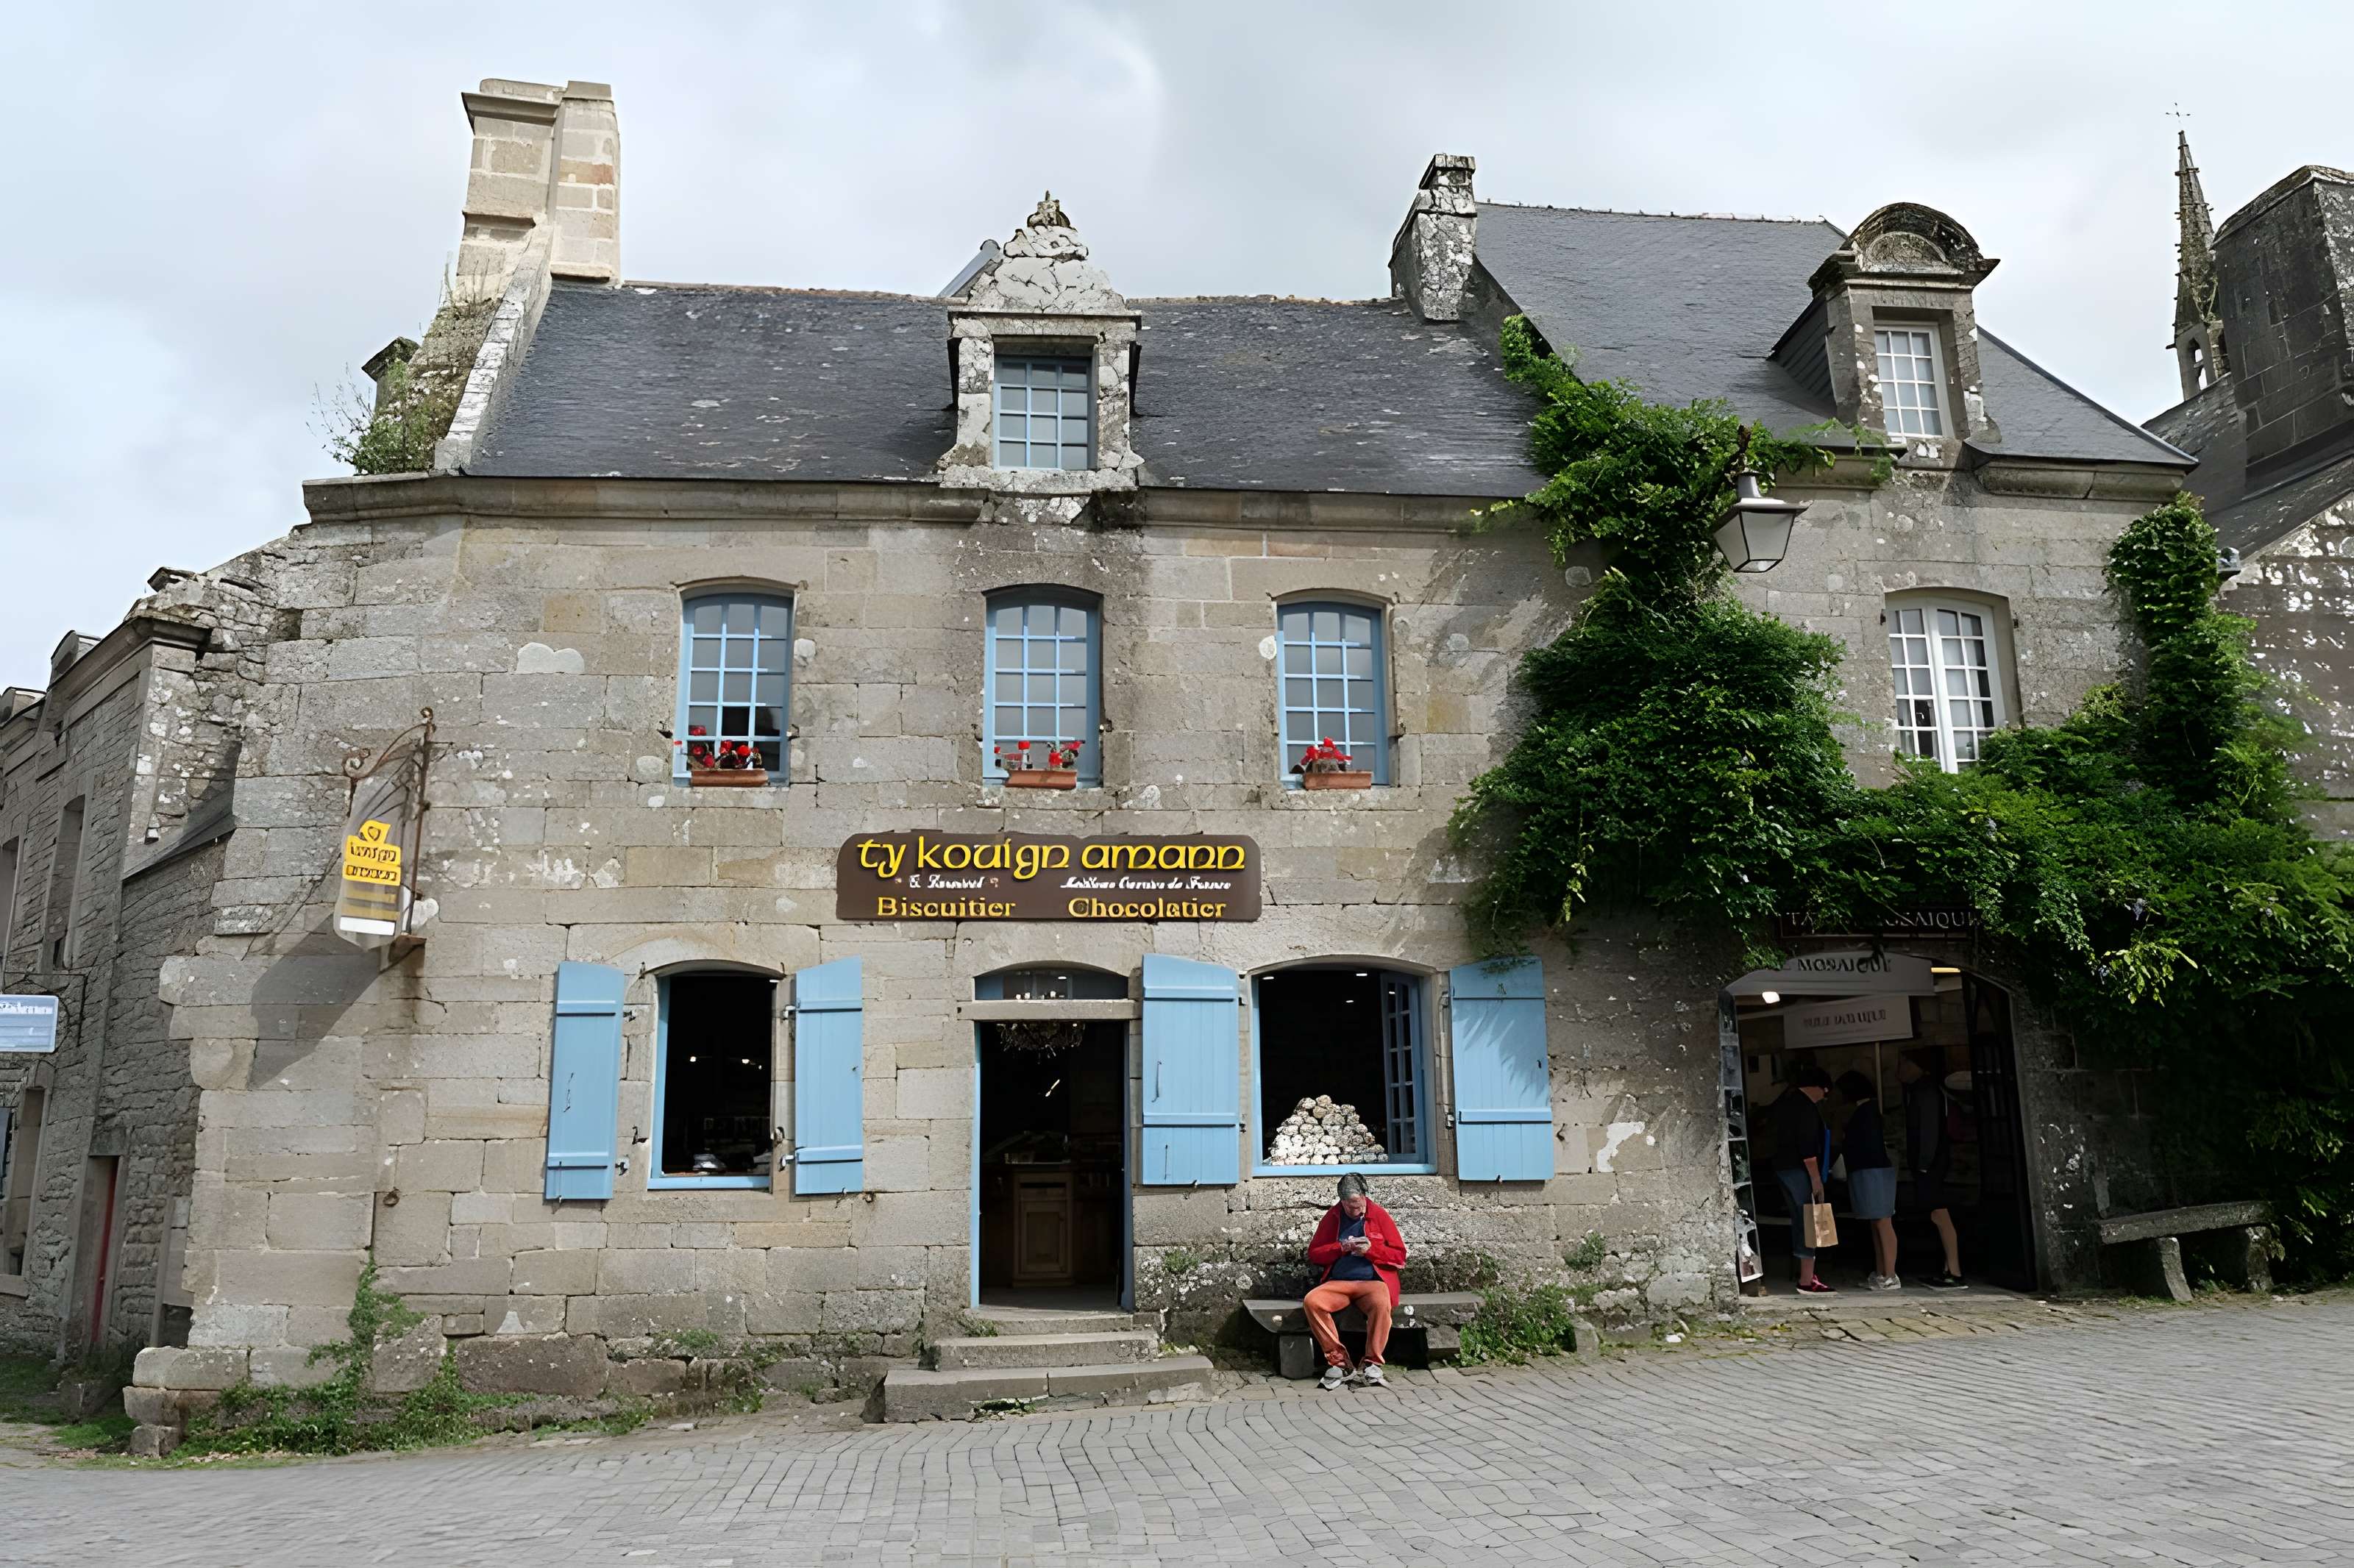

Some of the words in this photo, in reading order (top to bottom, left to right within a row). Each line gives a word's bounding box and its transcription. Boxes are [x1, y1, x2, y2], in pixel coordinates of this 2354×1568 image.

[857, 838, 906, 878] ty
[1081, 844, 1245, 869] amann
[877, 897, 1017, 917] Biscuitier
[1068, 897, 1227, 918] Chocolatier
